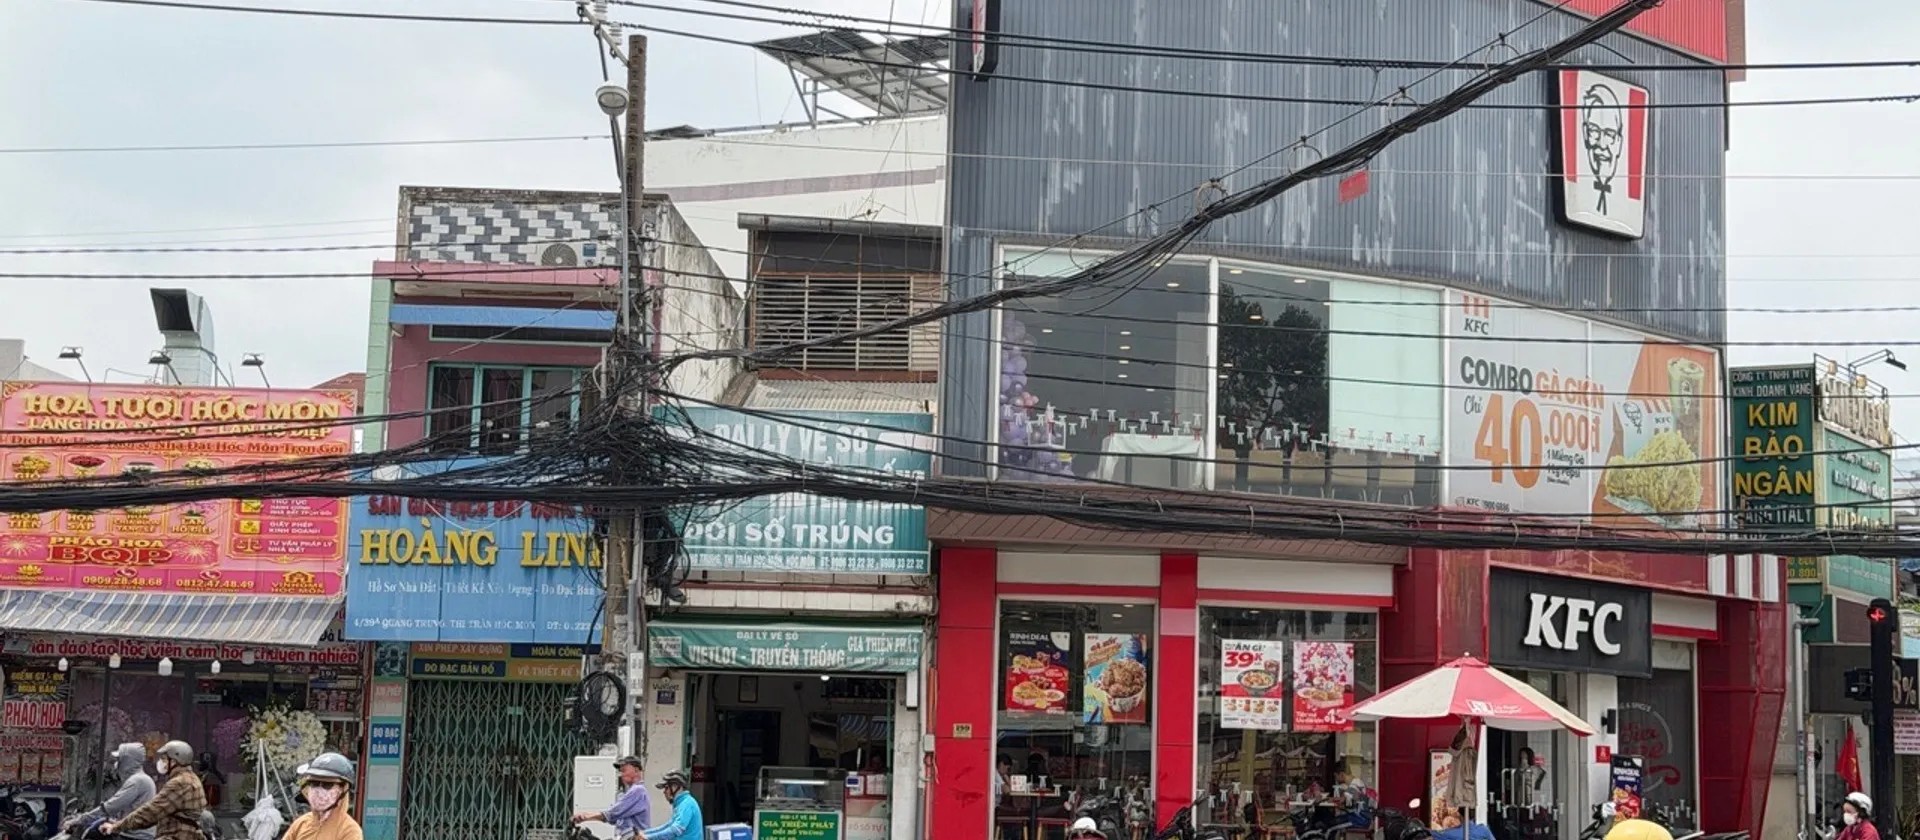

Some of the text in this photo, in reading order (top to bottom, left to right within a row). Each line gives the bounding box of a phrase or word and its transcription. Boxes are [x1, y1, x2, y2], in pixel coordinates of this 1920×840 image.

[1463, 318, 1490, 335] KFC
[1460, 355, 1533, 396] COMBO
[1756, 383, 1787, 397] DOANH
[25, 394, 98, 417] HOA
[264, 397, 341, 421] MÔN
[1748, 401, 1799, 427] KIM
[1744, 430, 1804, 462] BẢO
[1734, 465, 1813, 497] NGÂN
[50, 535, 166, 548] PHÁO HOA
[359, 516, 499, 566] HOÀNG
[744, 516, 787, 542] SỐ
[791, 518, 896, 545] TRÚNG
[46, 544, 172, 567] BQP
[381, 618, 413, 631] QUANG
[1523, 591, 1623, 656] KFC
[848, 635, 864, 653] GIA
[1030, 633, 1049, 642] DEAL
[803, 641, 846, 667] THỐNG
[4, 696, 65, 729] PHÁO HOA
